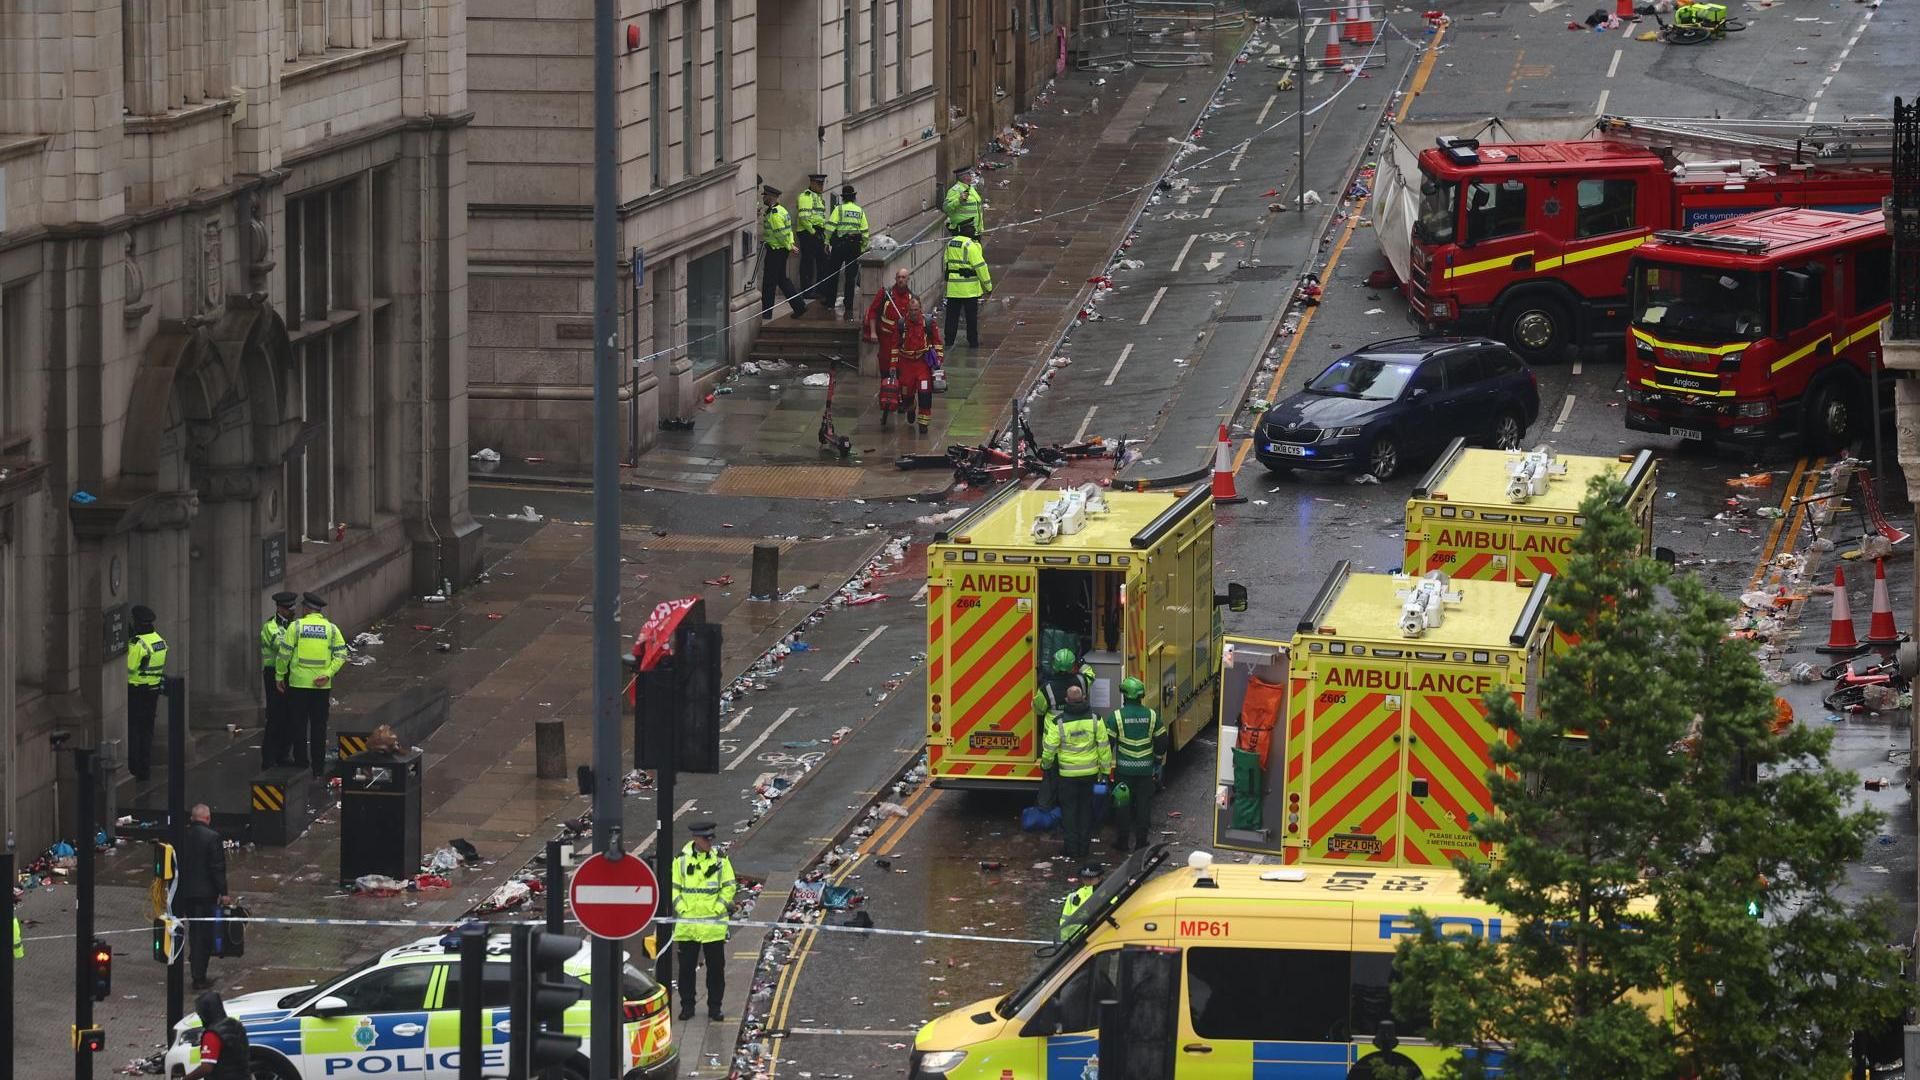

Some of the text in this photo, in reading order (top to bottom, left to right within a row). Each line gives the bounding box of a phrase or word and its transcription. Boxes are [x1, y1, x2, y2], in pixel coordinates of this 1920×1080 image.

[845, 210, 860, 218] POLICE
[1693, 212, 1707, 220] Got
[1673, 377, 1700, 388] Angloco
[1436, 528, 1576, 555] AMBULANC
[959, 574, 1036, 593] AMBU
[303, 624, 326, 634] POLICE
[1325, 667, 1492, 694] AMBULANCE
[975, 735, 999, 746] DF24
[1429, 832, 1453, 840] PLEASE
[1334, 839, 1380, 851] DF24 OHX
[1180, 920, 1229, 937] MP61
